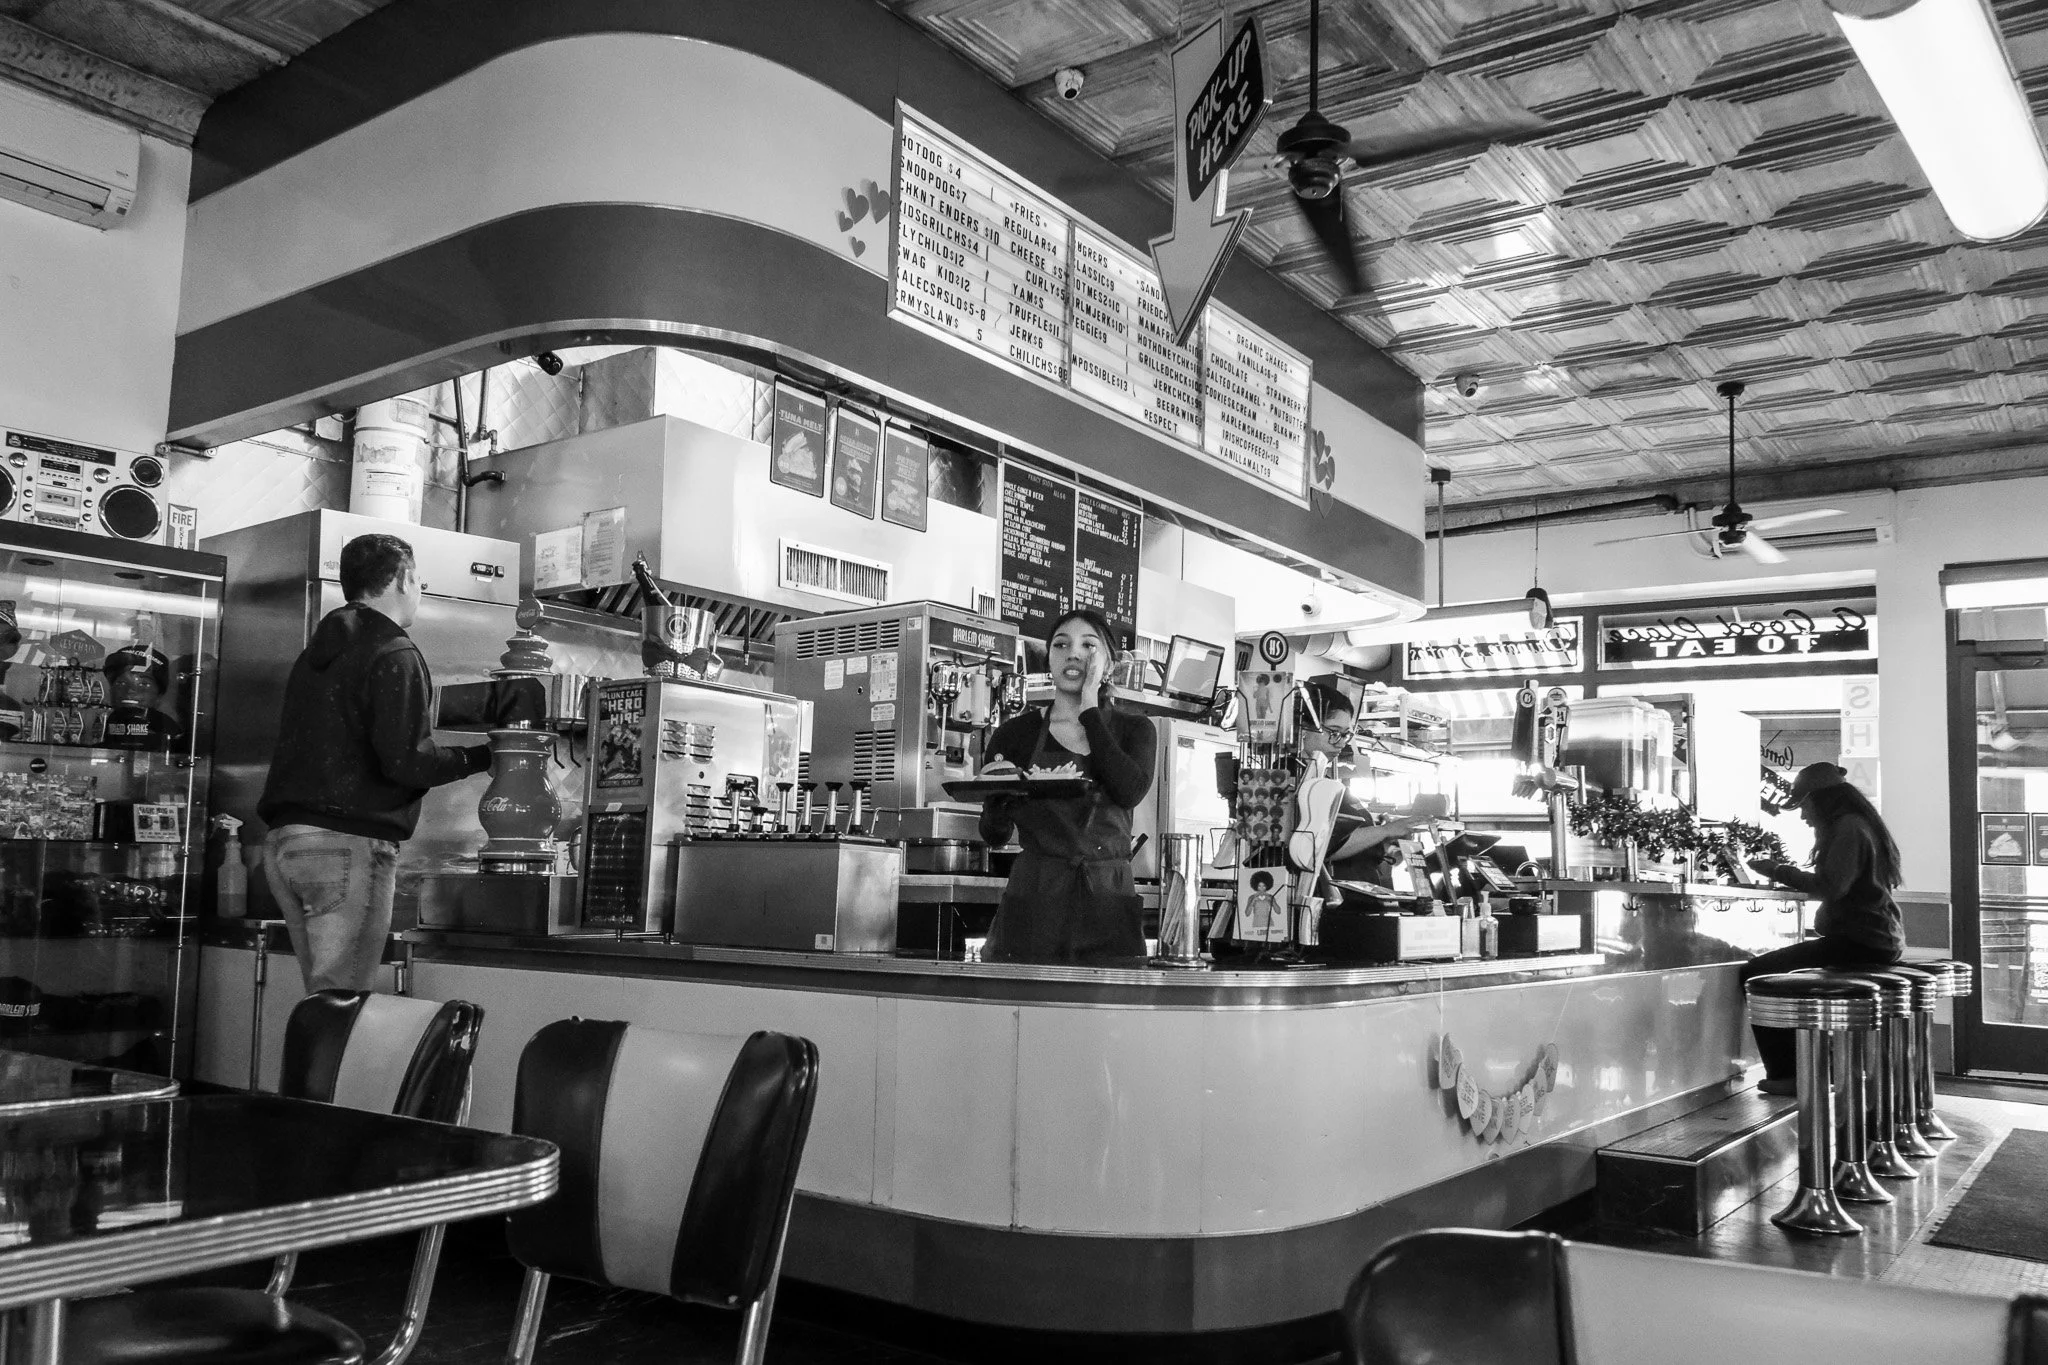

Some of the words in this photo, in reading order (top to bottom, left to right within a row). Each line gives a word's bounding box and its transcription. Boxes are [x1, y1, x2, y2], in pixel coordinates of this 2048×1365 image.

[1189, 30, 1251, 150] PICK-UP
[1199, 81, 1251, 182] HERE
[1014, 201, 1040, 227] FRIES
[1004, 215, 1056, 256] REGULAR$4
[1011, 240, 1045, 270] CHEESE
[1008, 301, 1059, 338] TRUFFLE$11
[1072, 314, 1106, 343] EGGIE$9
[1010, 323, 1042, 349] JERK$6
[1236, 332, 1263, 358] ORGANIC
[1265, 351, 1287, 372] SHAKES
[1210, 352, 1247, 383] CHOCOLATE
[1206, 366, 1230, 390] SALTED
[1232, 381, 1260, 406] CARAMEL
[172, 512, 193, 526] FIRE
[952, 627, 977, 647] HARLEM
[978, 632, 996, 649] SHAKE
[608, 697, 642, 712] HERO
[626, 689, 643, 698] CAGE
[126, 723, 149, 736] SHAKE
[610, 711, 640, 725] HIRE
